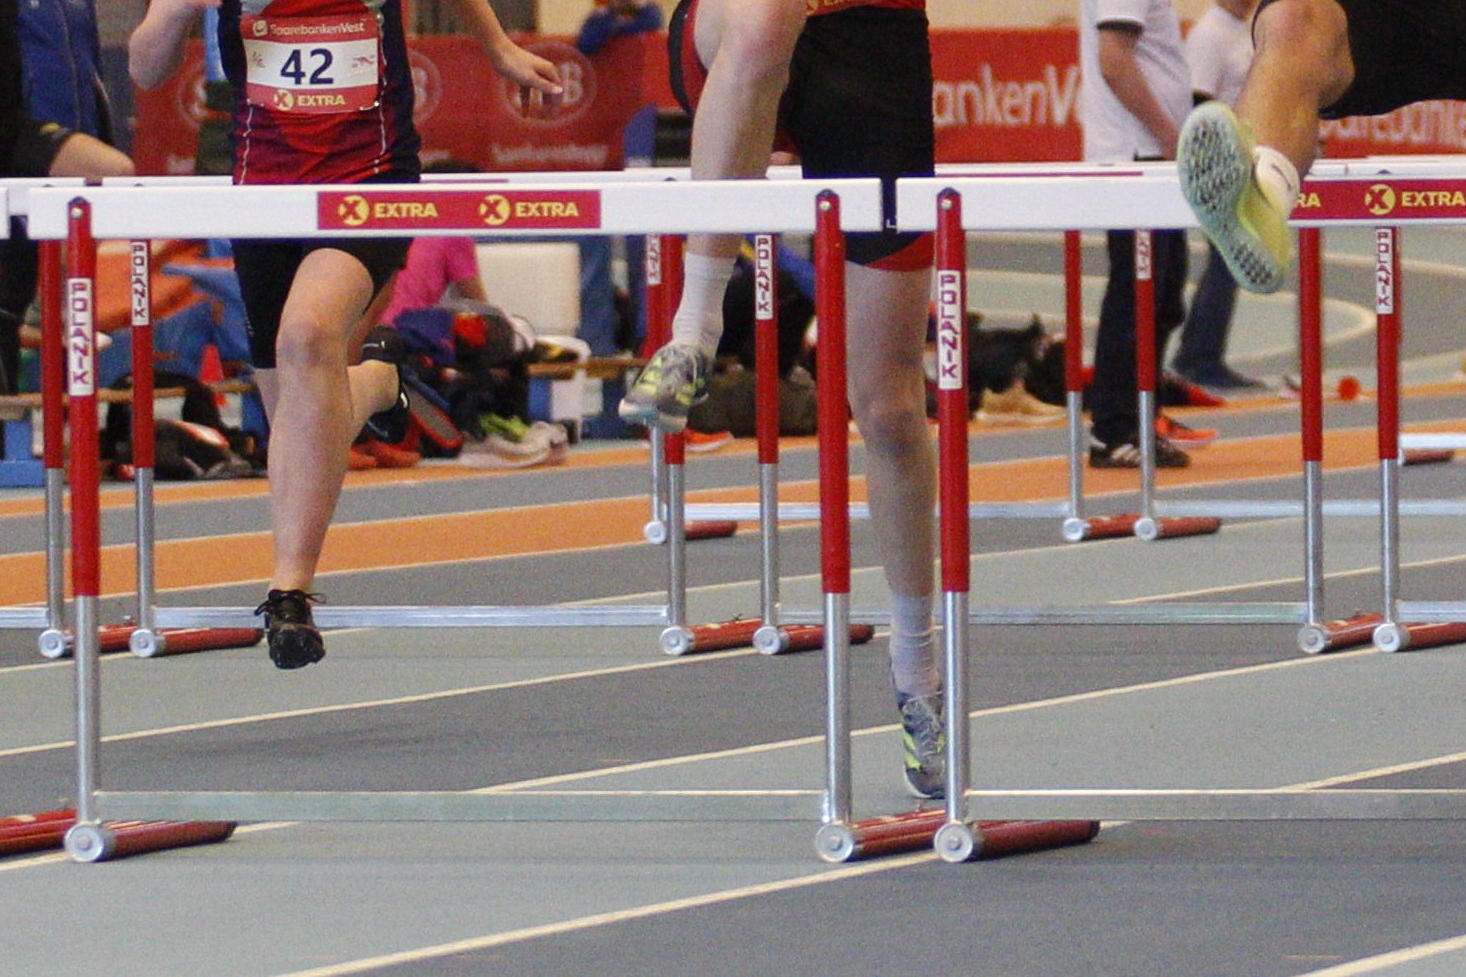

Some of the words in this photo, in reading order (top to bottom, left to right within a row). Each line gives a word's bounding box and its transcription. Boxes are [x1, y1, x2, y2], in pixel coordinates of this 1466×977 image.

[269, 22, 365, 36] SparebankenVest
[280, 47, 334, 85] 42
[297, 94, 346, 106] EXTRA
[373, 202, 439, 218] EXTRA
[515, 201, 580, 217] EXTRA
[1401, 190, 1466, 207] EXTRA
[132, 244, 148, 318] POLANIK
[757, 237, 770, 312] POLANIK
[1377, 231, 1391, 306] POLANIK
[72, 282, 91, 385] POLANIK
[940, 273, 961, 379] POLANIK
